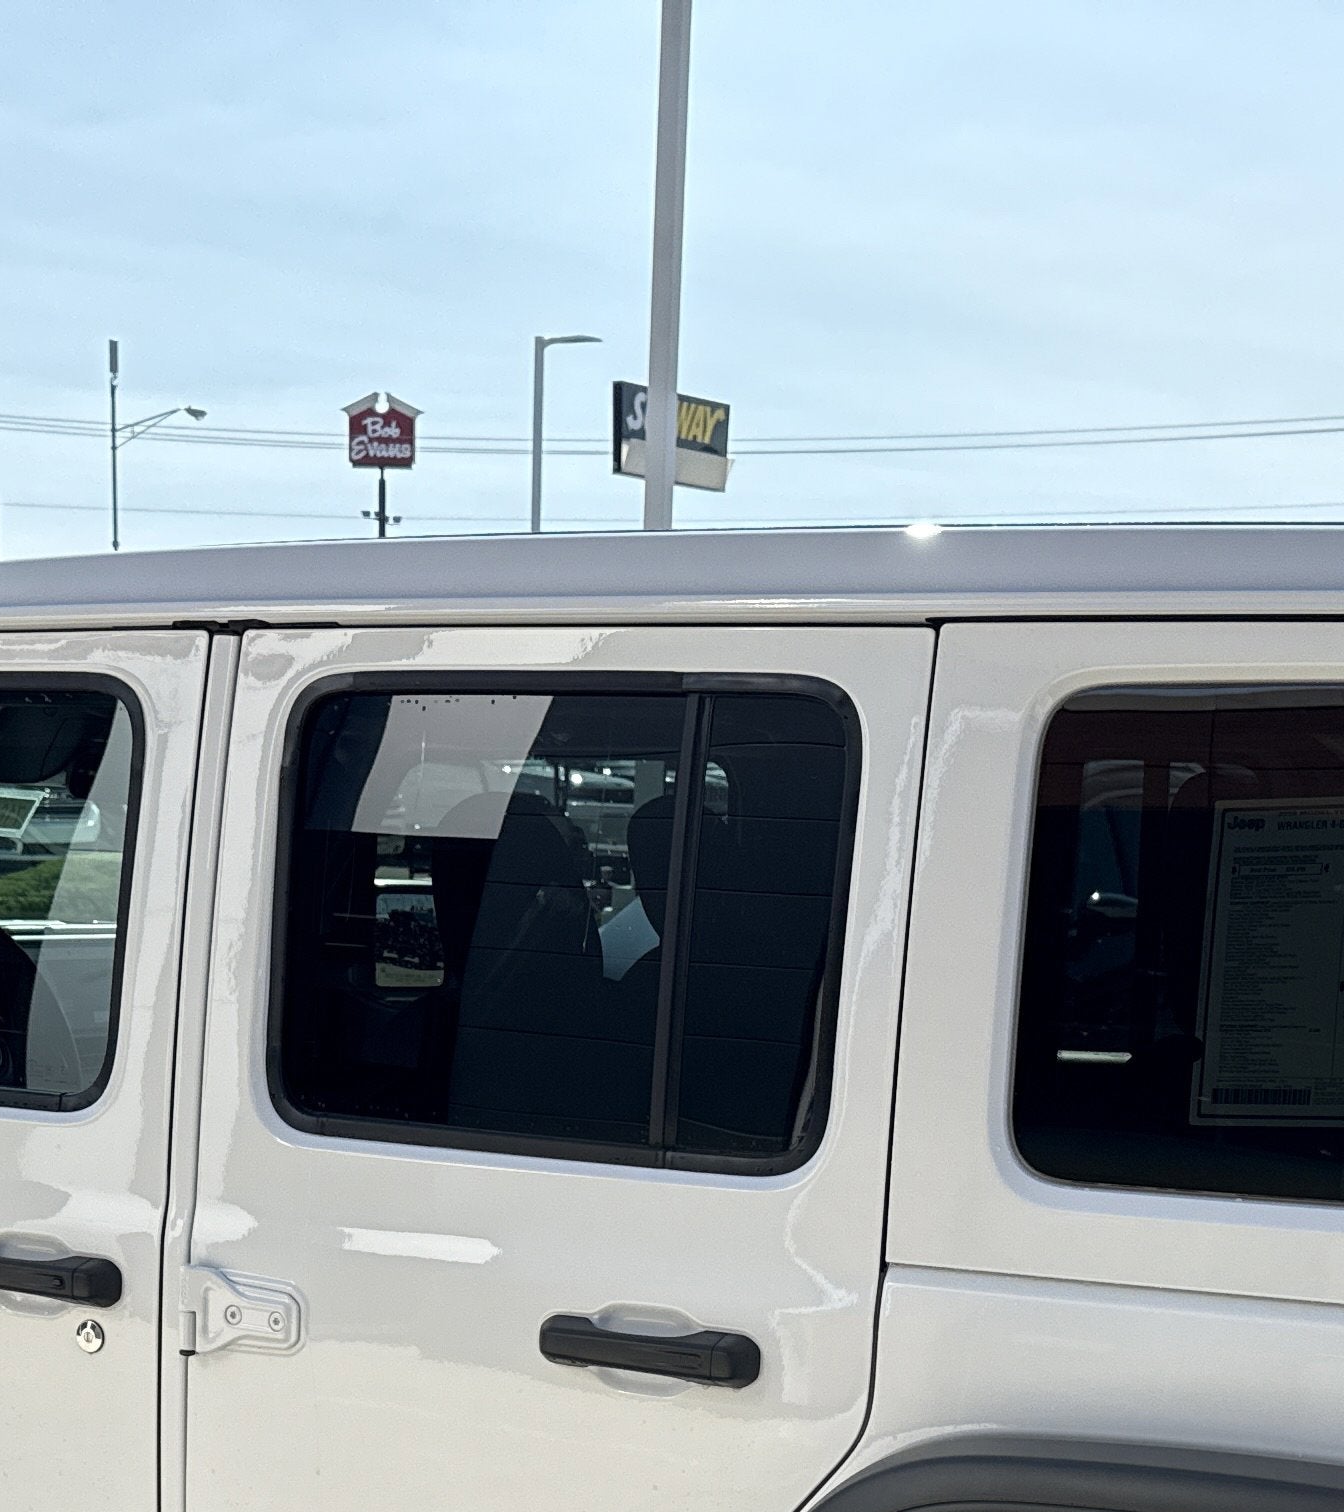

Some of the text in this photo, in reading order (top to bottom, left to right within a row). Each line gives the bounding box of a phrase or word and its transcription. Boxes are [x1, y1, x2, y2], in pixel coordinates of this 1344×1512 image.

[362, 416, 401, 438] Bob
[626, 392, 725, 444] SWAY
[352, 435, 411, 460] Evans
[1227, 815, 1266, 832] Jeep
[1277, 819, 1327, 831] WRANGLER
